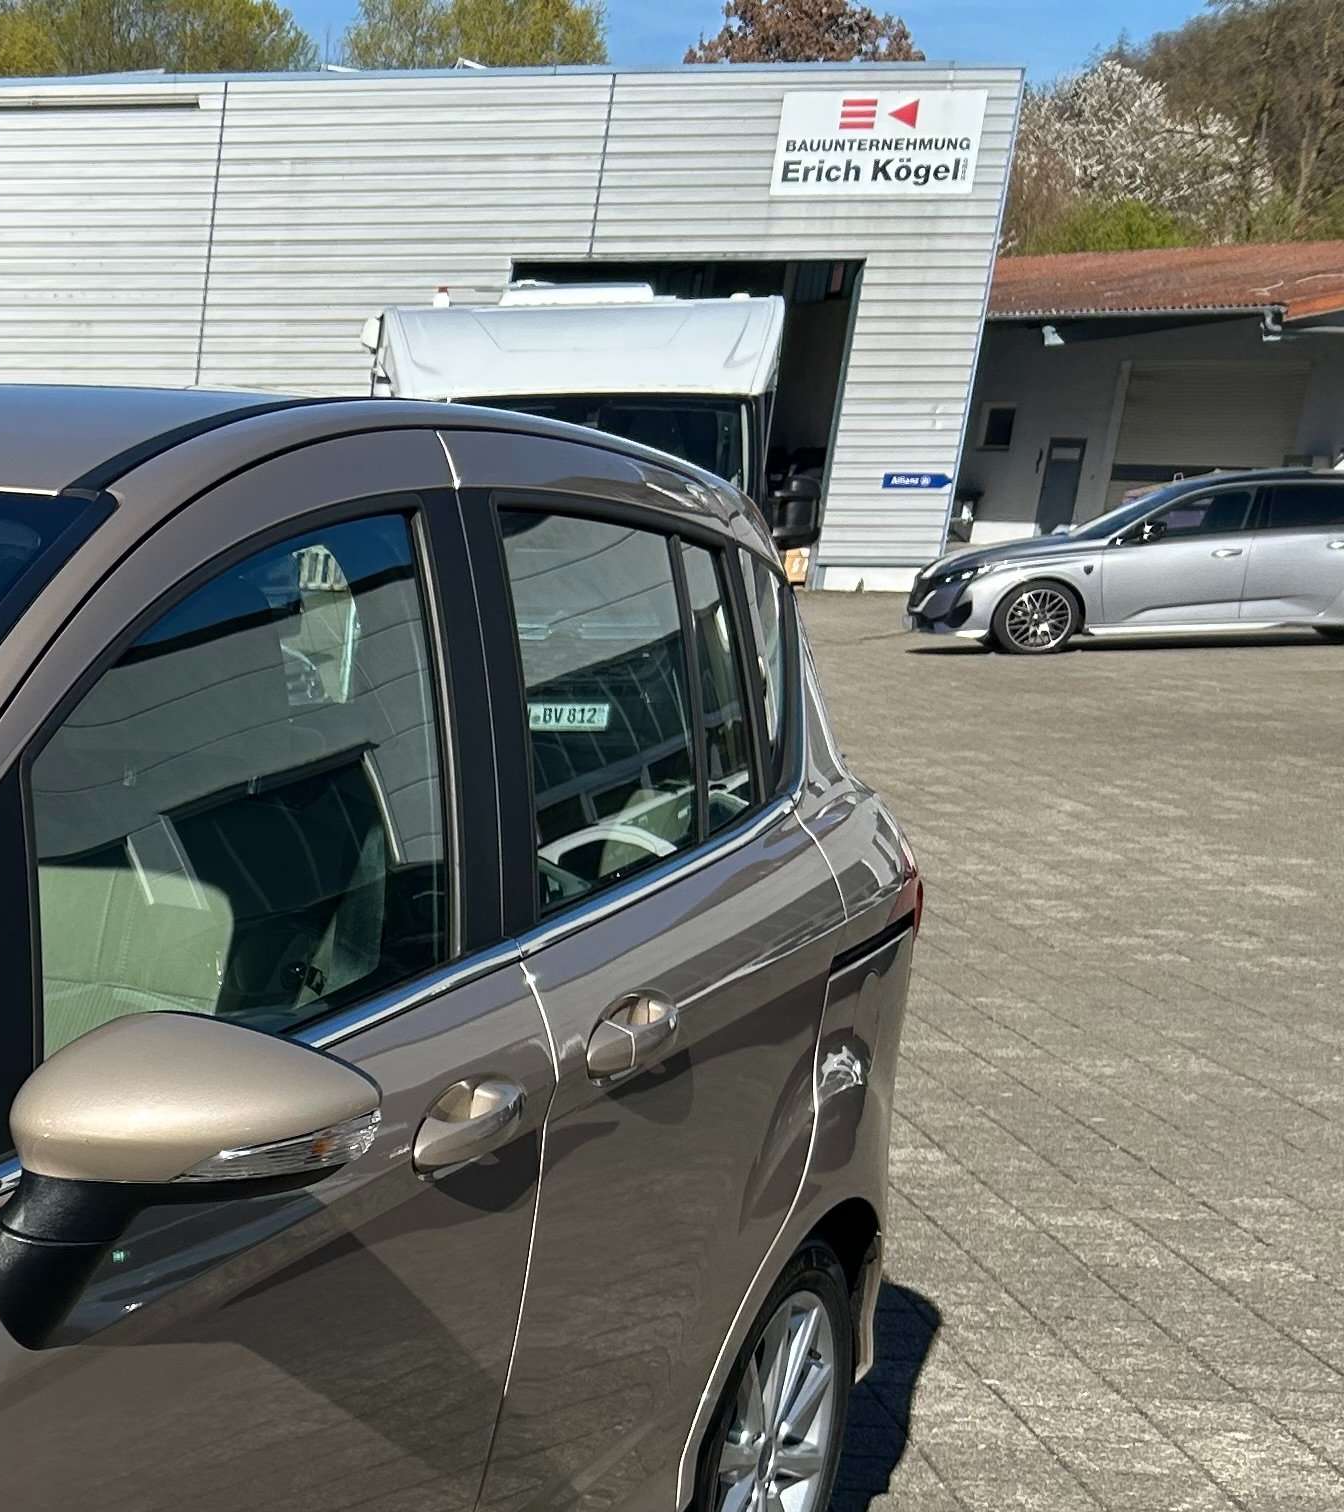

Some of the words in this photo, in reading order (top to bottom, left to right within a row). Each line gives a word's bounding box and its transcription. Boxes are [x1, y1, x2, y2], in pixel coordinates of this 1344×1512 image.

[785, 137, 971, 153] BAUUNTERNEHMUNG
[781, 159, 861, 183] Erich
[871, 157, 962, 187] Kögel
[891, 475, 920, 486] Allianz
